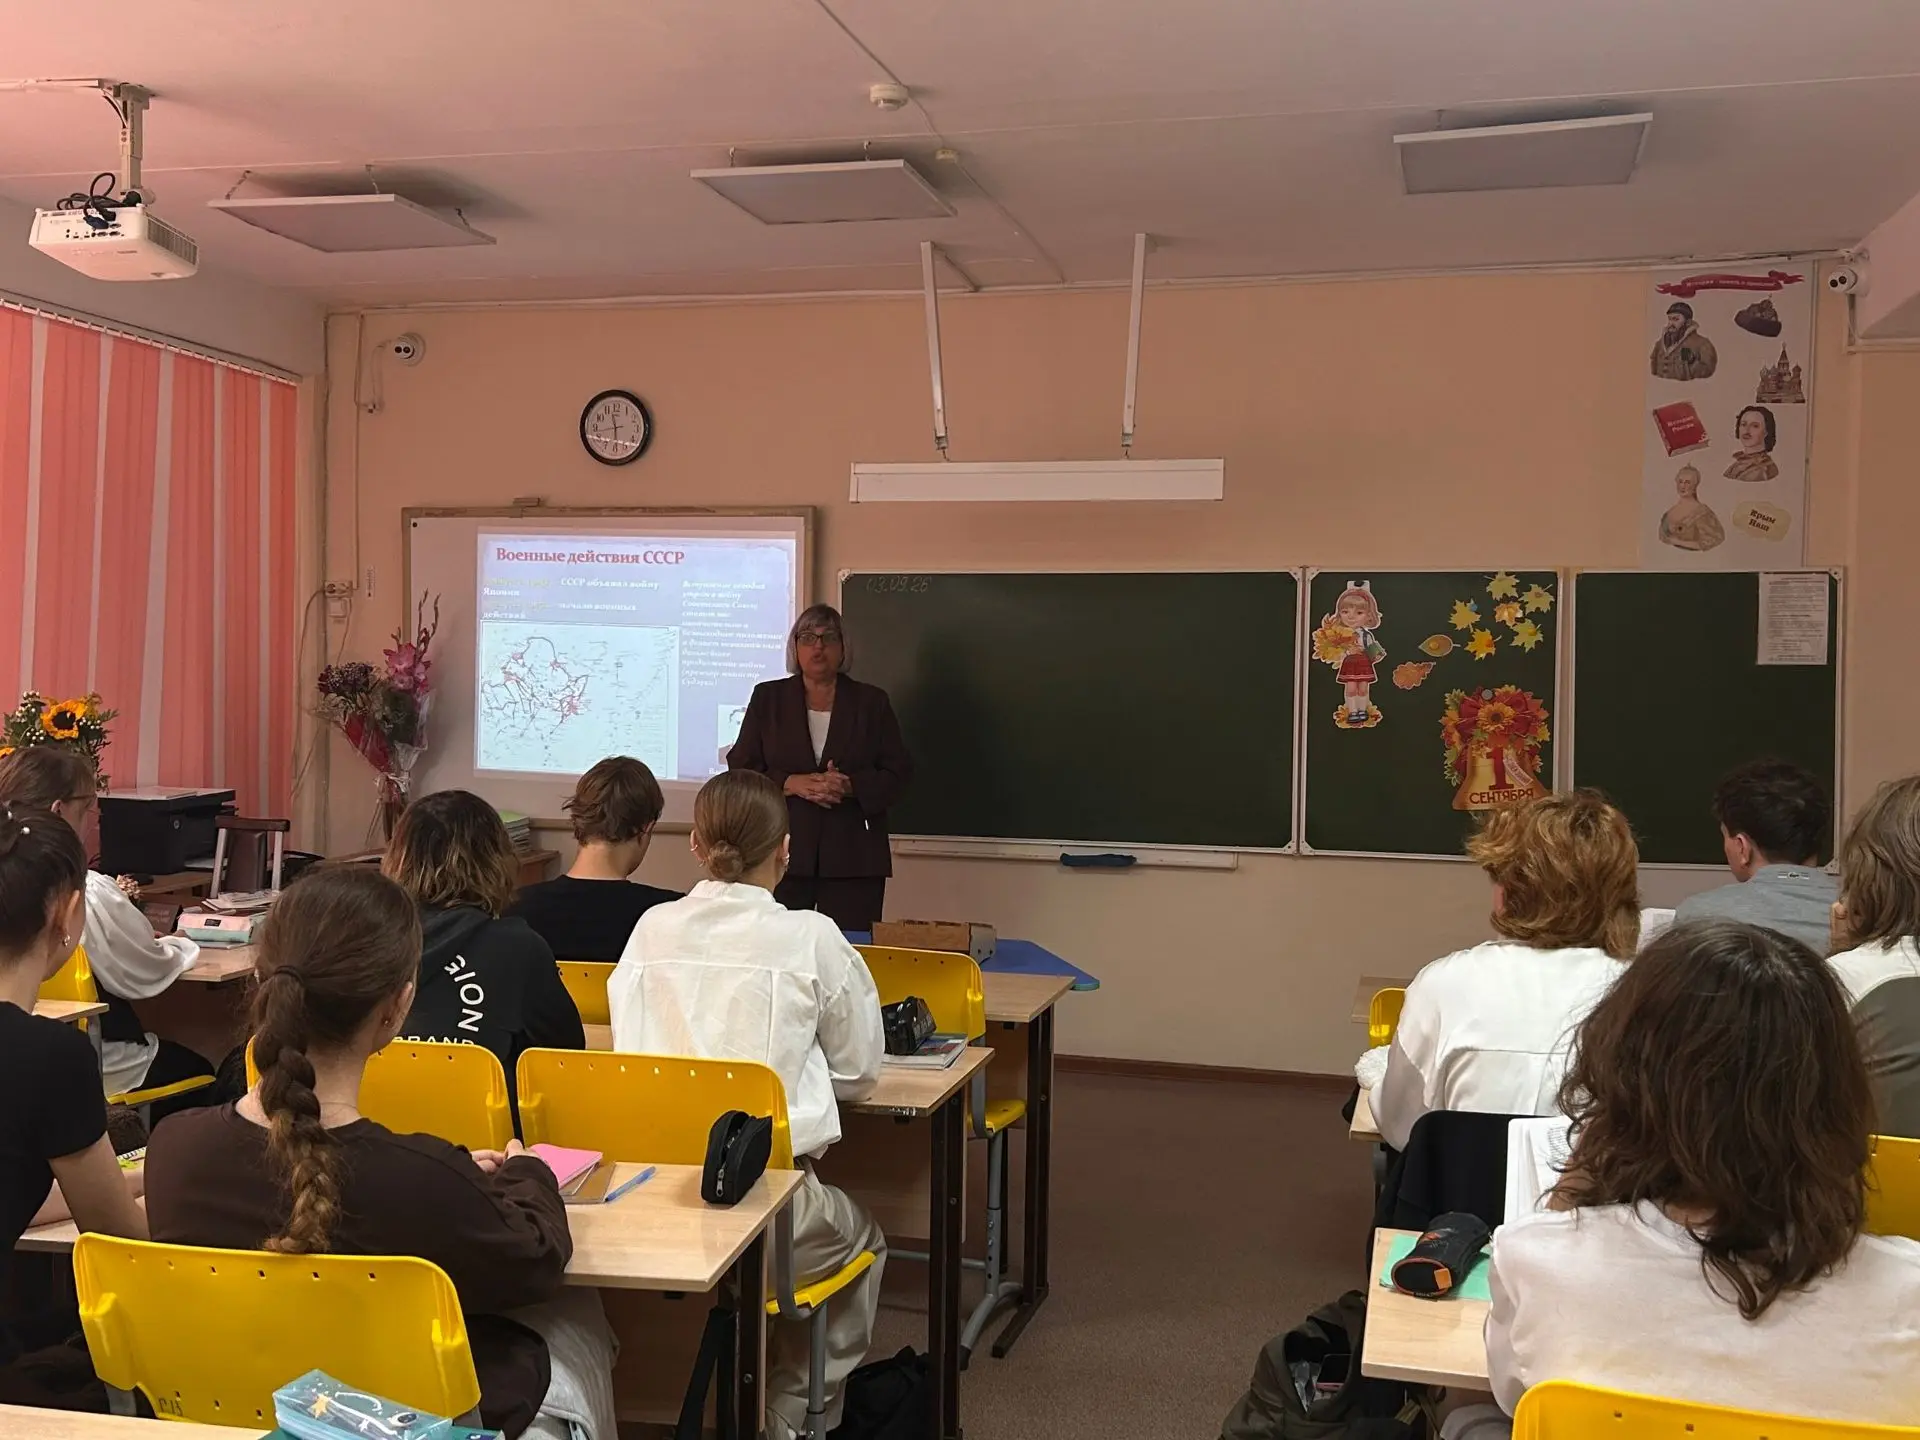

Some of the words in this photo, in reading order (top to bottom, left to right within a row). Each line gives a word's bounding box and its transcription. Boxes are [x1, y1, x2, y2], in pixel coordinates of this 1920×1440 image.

[1750, 509, 1776, 524] Крым
[1748, 519, 1770, 531] Наш
[496, 547, 565, 563] Военные
[567, 550, 640, 565] действия
[643, 550, 685, 564] СССР
[560, 577, 585, 587] СССР
[482, 586, 521, 597] Японии
[1485, 746, 1514, 790] 1
[1469, 788, 1534, 804] СЕНТЯБРЯ
